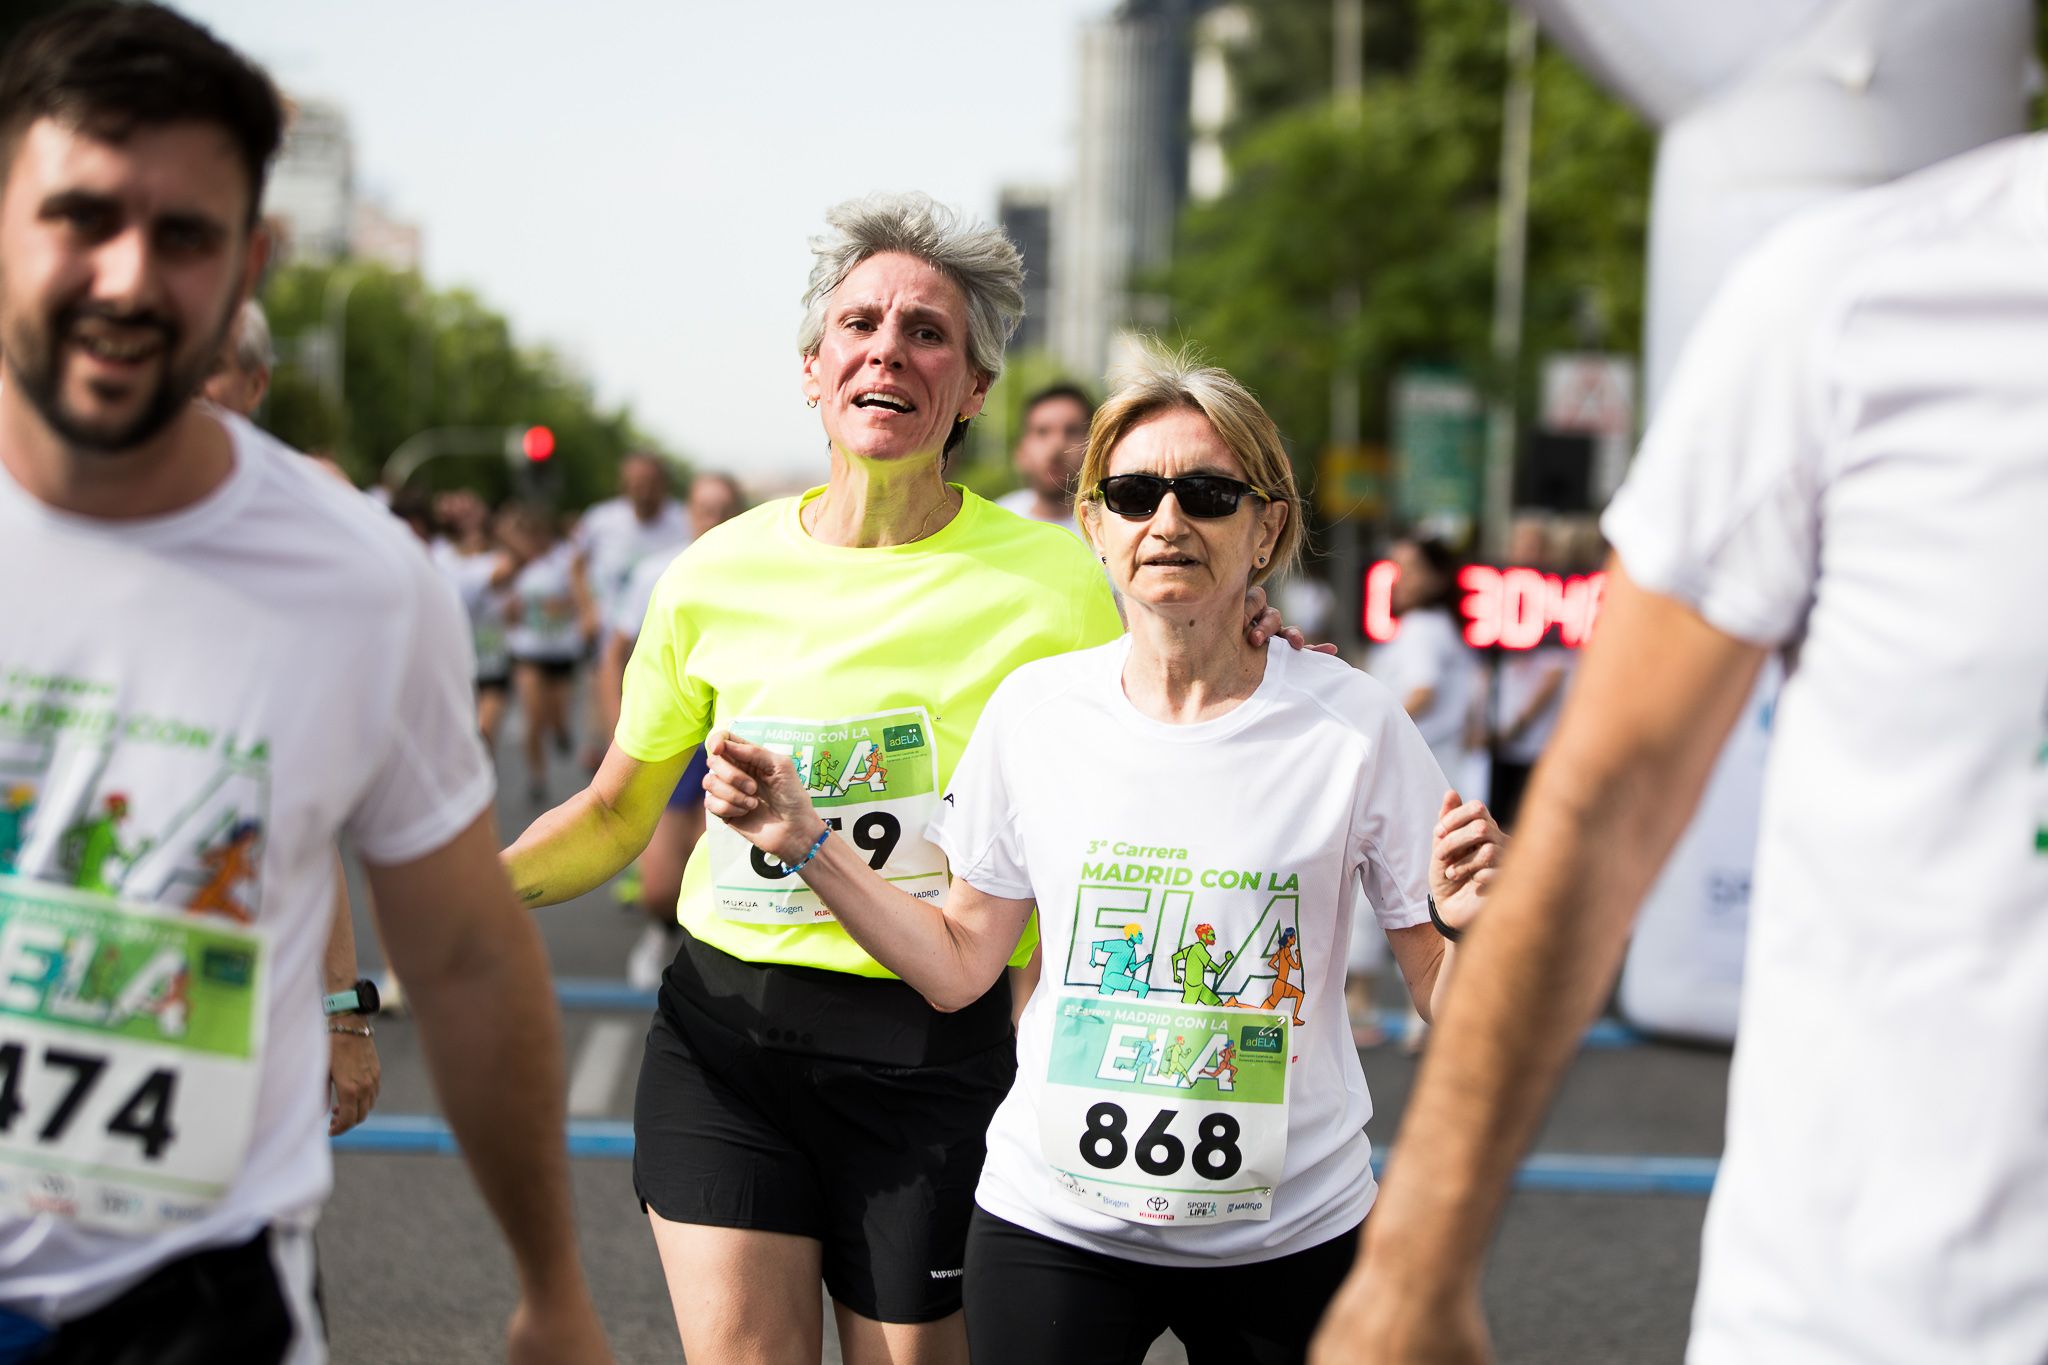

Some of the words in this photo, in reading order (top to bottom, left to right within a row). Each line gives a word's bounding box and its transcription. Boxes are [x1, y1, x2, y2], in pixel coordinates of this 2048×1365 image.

[765, 728, 814, 743] MADRID
[818, 729, 848, 744] CON
[852, 727, 870, 739] LA
[889, 734, 919, 747] adELA
[1112, 842, 1188, 860] Carrera
[1081, 862, 1193, 886] MADRID
[1200, 869, 1262, 891] CON
[1267, 873, 1299, 892] LA
[722, 899, 759, 908] MUKUA
[775, 904, 804, 915] Biogen
[1063, 884, 1305, 996] ELA
[1114, 1009, 1172, 1026] MADRID
[1175, 1016, 1207, 1029] CON
[1210, 1019, 1229, 1031] LA
[1246, 1037, 1277, 1048] adELA
[1095, 1023, 1235, 1092] ELA
[1079, 1101, 1242, 1181] 868
[1187, 1201, 1211, 1209] SPORT
[1189, 1208, 1207, 1216] LIFE
